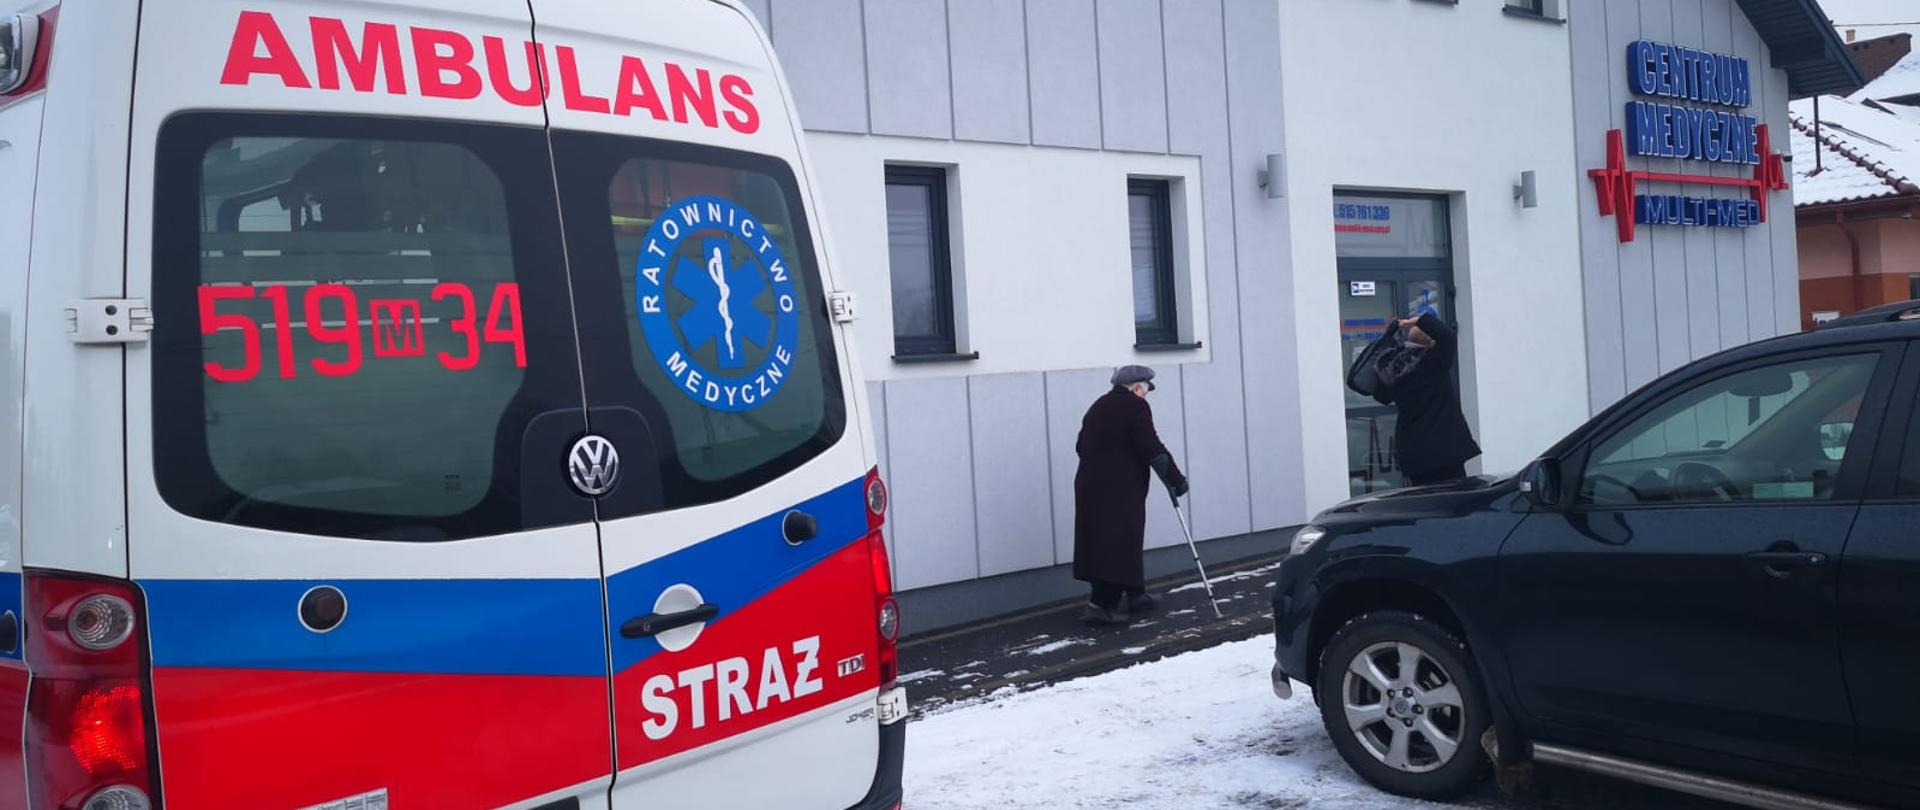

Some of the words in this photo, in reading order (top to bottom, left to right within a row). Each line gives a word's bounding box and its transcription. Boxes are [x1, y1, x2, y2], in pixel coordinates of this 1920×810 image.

[220, 10, 760, 135] AMBULANS
[1628, 39, 1752, 108] CENTRUM
[1626, 100, 1761, 165] MEDYCZNE
[1635, 194, 1761, 227] MULTI-MED
[642, 202, 794, 313] RATOWNICTWO
[197, 284, 364, 383] 519
[431, 282, 528, 371] 34
[666, 345, 792, 406] MEDYCZNE
[837, 653, 865, 677] TDI
